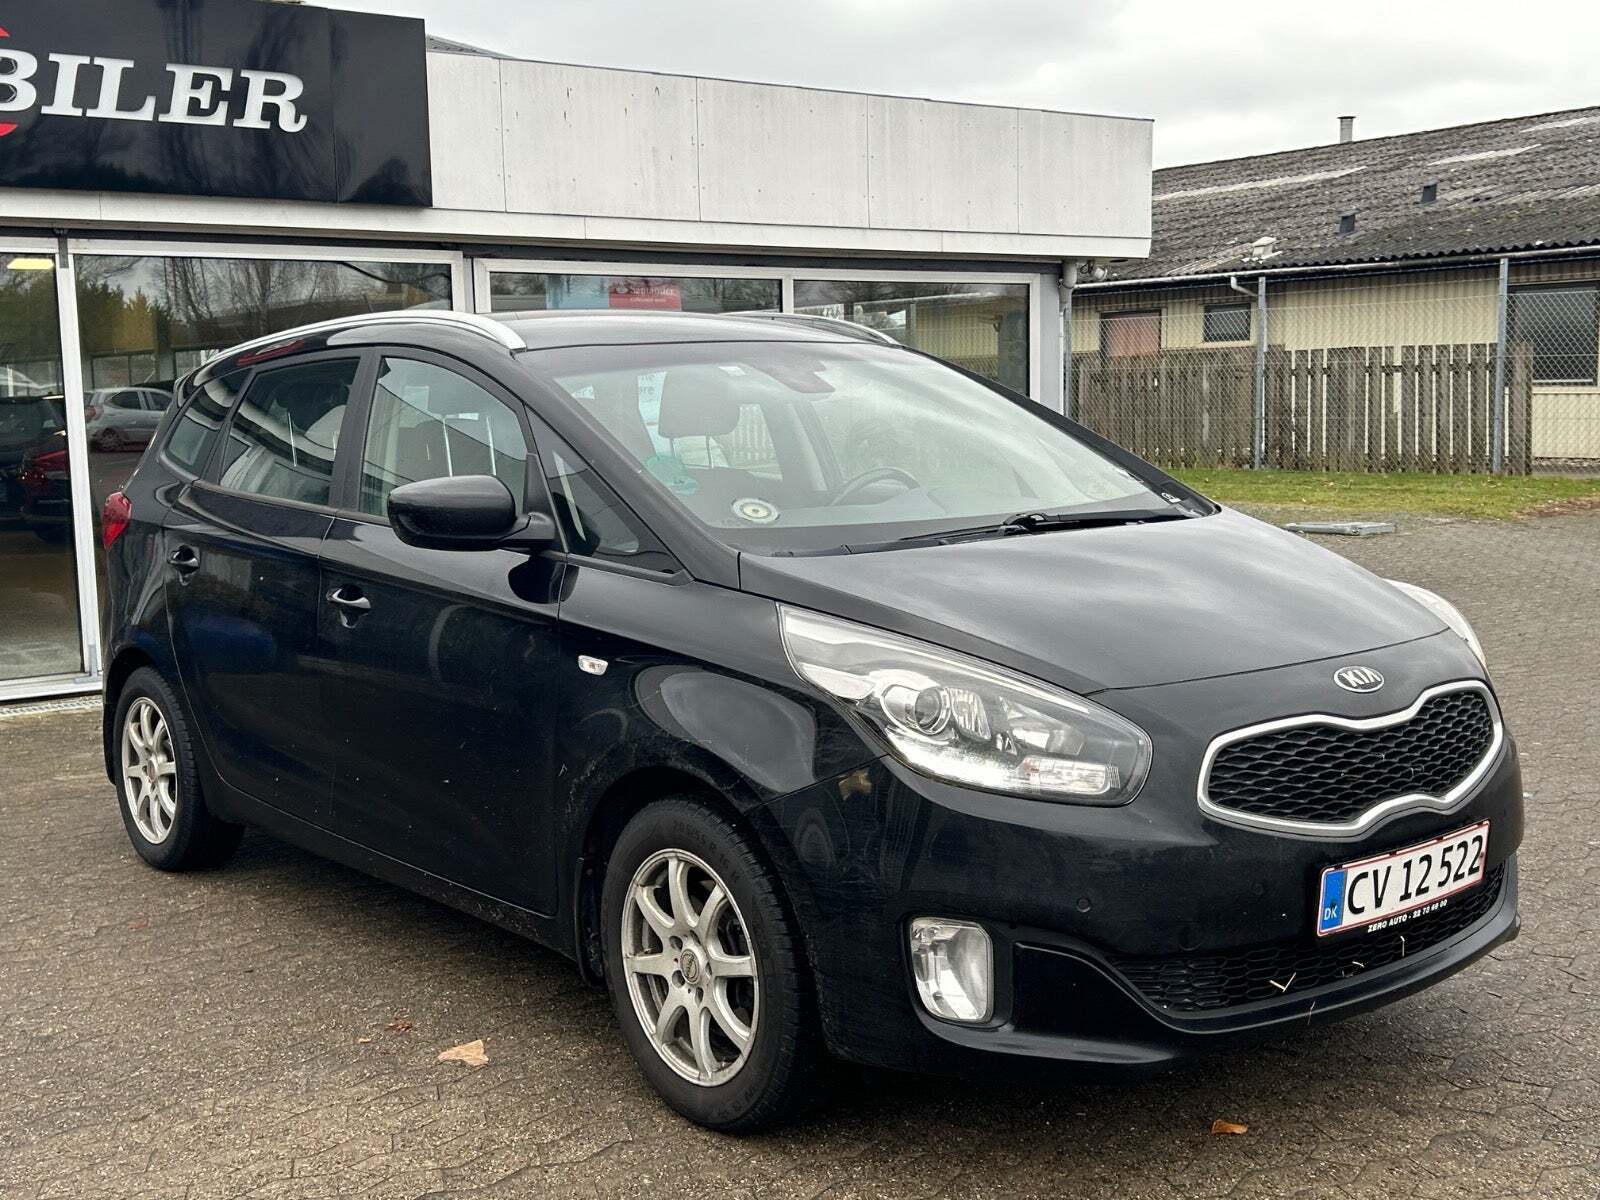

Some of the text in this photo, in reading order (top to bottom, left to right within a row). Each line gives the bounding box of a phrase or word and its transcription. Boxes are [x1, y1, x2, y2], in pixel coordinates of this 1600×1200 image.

[0, 48, 308, 133] BILER
[1338, 669, 1382, 688] KIA
[1347, 835, 1483, 914] CV 12 522
[1323, 906, 1338, 921] DK
[1367, 920, 1388, 933] ZERO
[1388, 914, 1408, 927] AUTO
